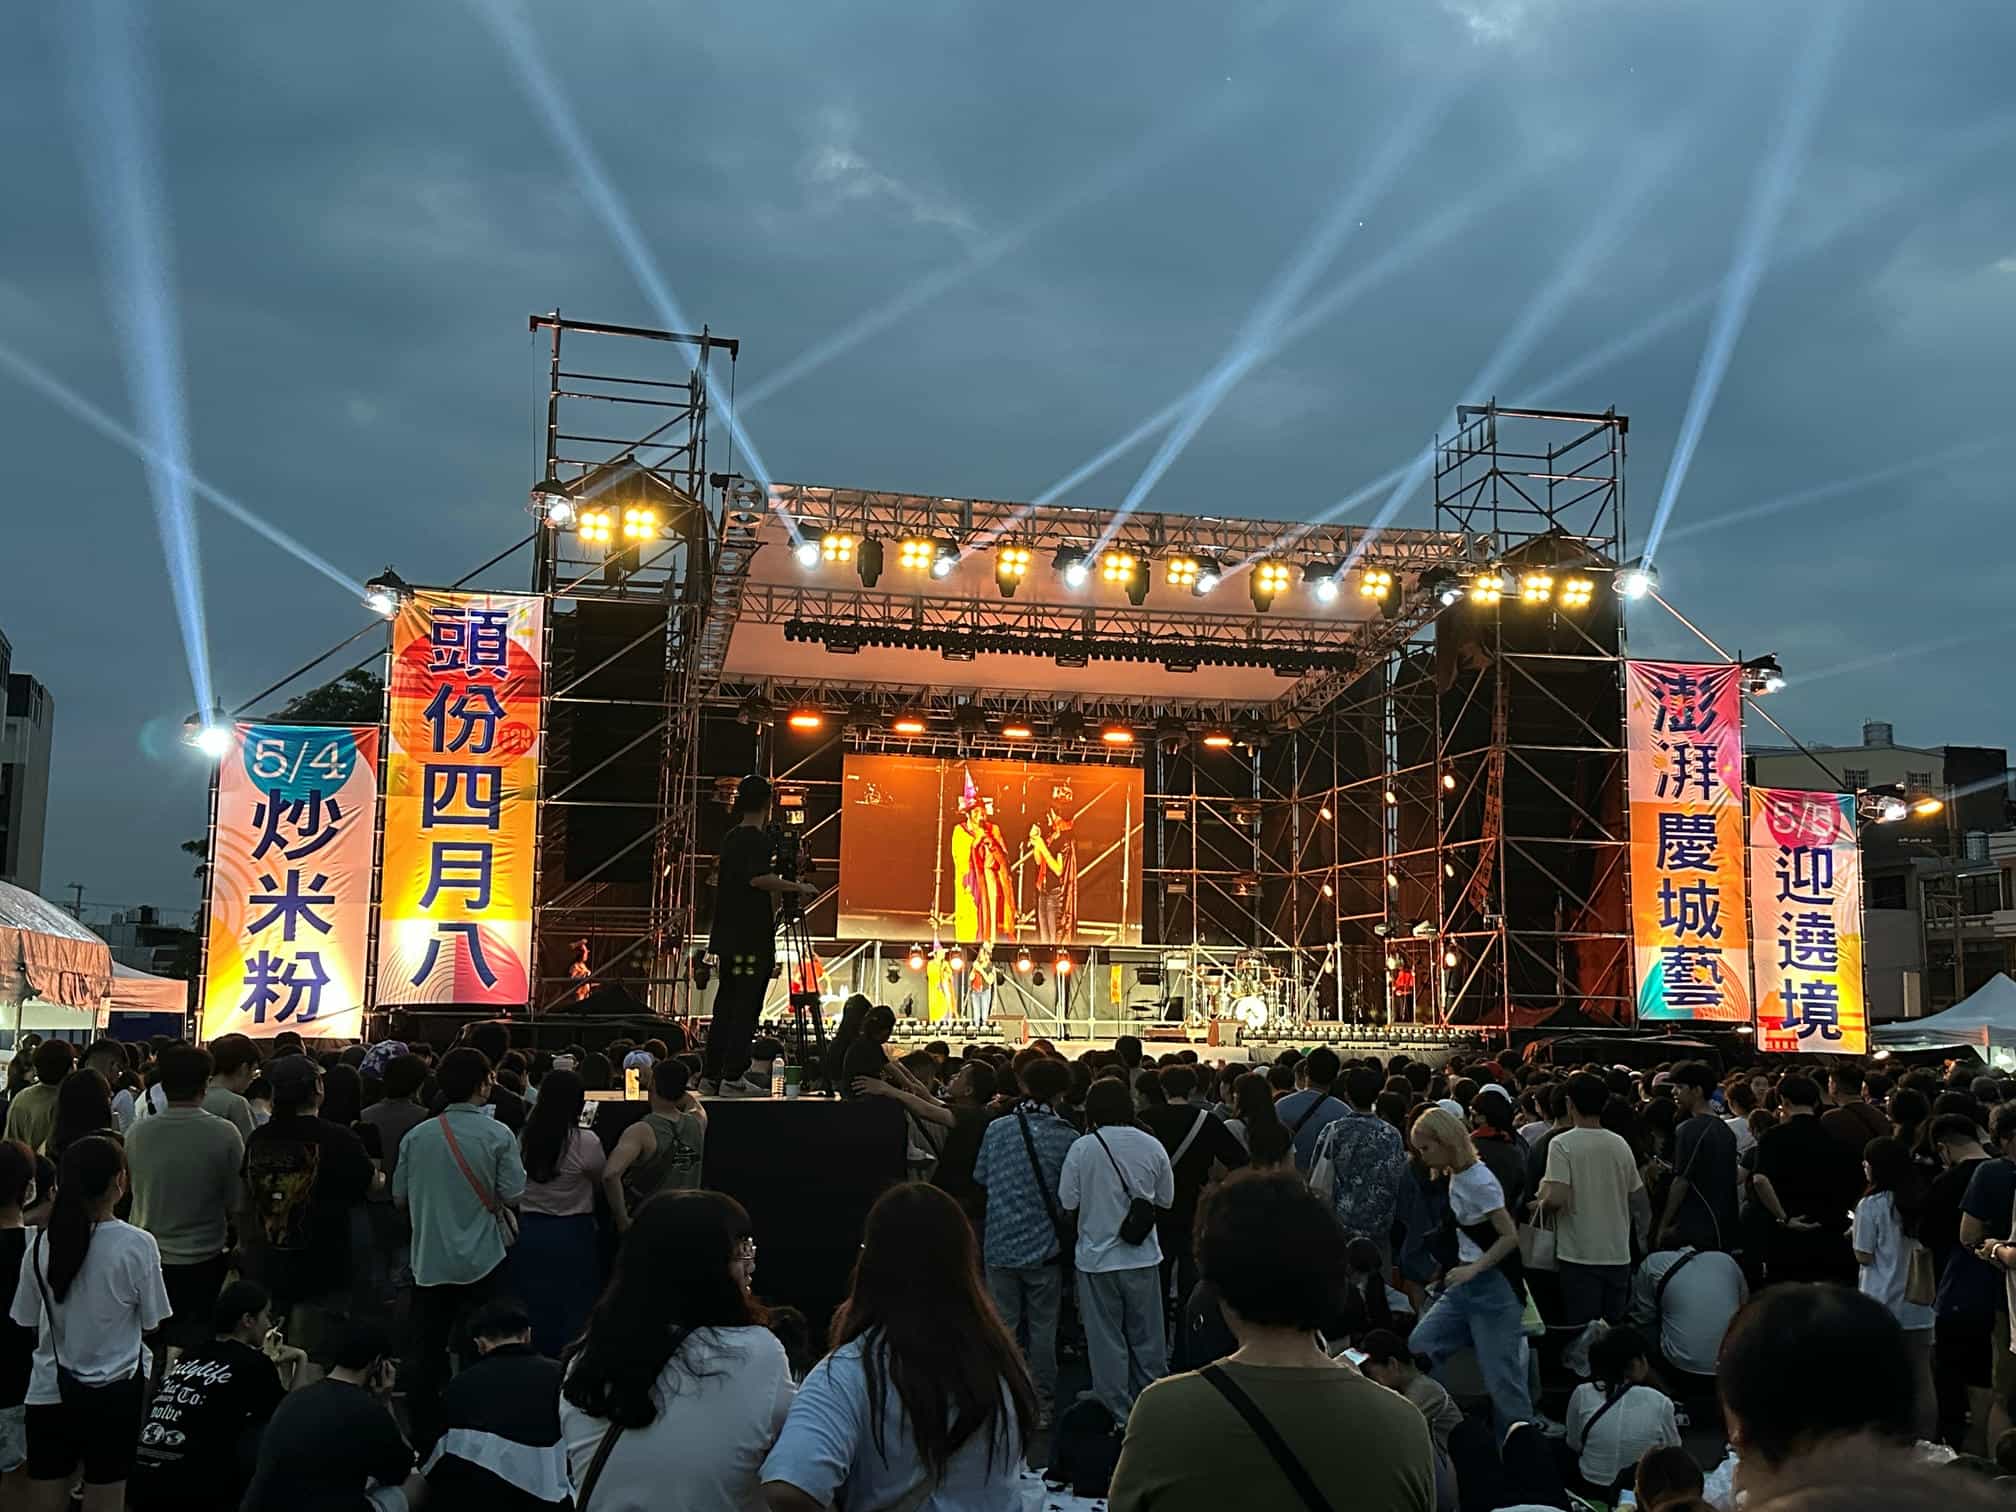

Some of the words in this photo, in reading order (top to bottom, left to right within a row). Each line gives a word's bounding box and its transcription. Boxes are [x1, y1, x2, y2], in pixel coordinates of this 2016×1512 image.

[253, 738, 348, 783] 5/4
[411, 606, 507, 990] 頭份四月八
[1652, 673, 1725, 1008] 澎湃慶城藝
[1773, 801, 1834, 837] 5/5
[240, 788, 343, 1025] 炒米粉
[1776, 845, 1842, 1042] 迎遶境
